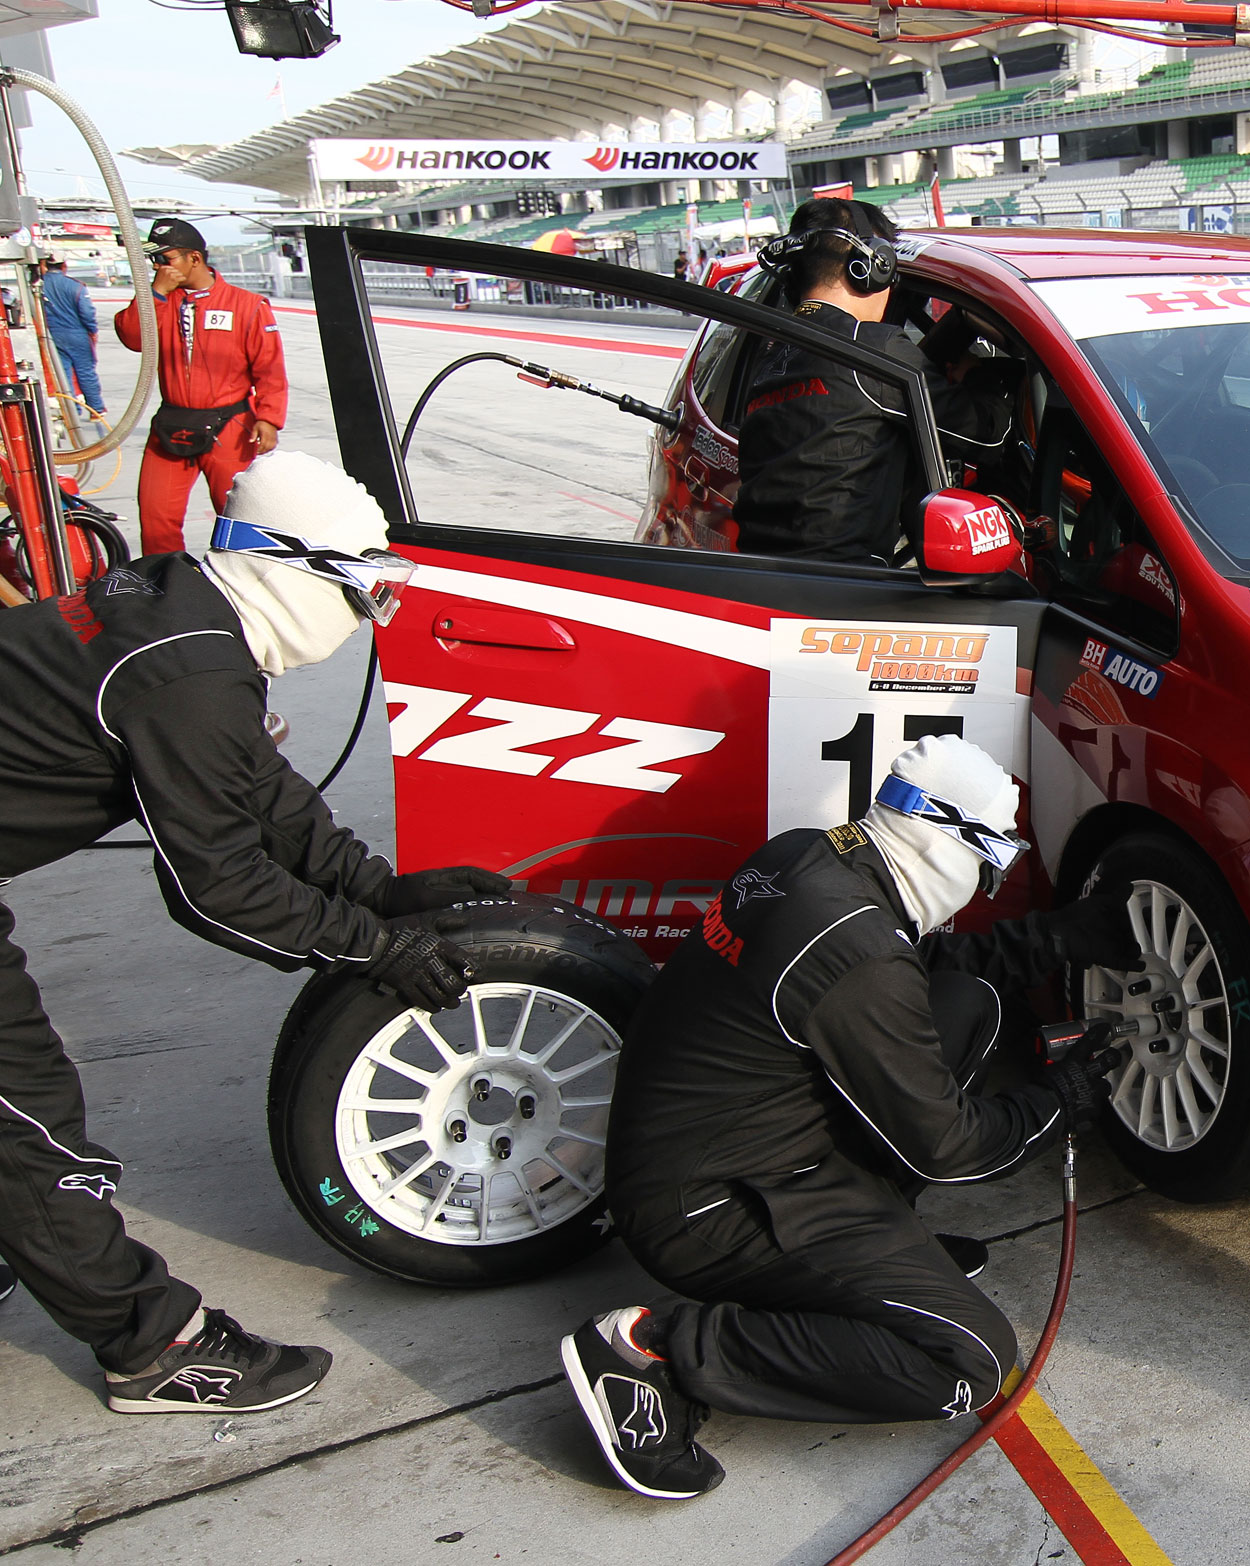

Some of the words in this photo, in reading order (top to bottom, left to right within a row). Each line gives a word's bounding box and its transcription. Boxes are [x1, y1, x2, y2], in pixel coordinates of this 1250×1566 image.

[210, 314, 226, 327] 87
[747, 378, 829, 416] HONDA
[967, 509, 1008, 543] NGK
[57, 590, 104, 644] ONDA
[799, 627, 990, 671] Sepang
[1082, 640, 1106, 665] BH
[1104, 654, 1158, 696] AUTO
[871, 662, 979, 682] 1000km
[821, 713, 964, 824] 1
[500, 879, 725, 917] MR
[653, 925, 692, 939] Rac
